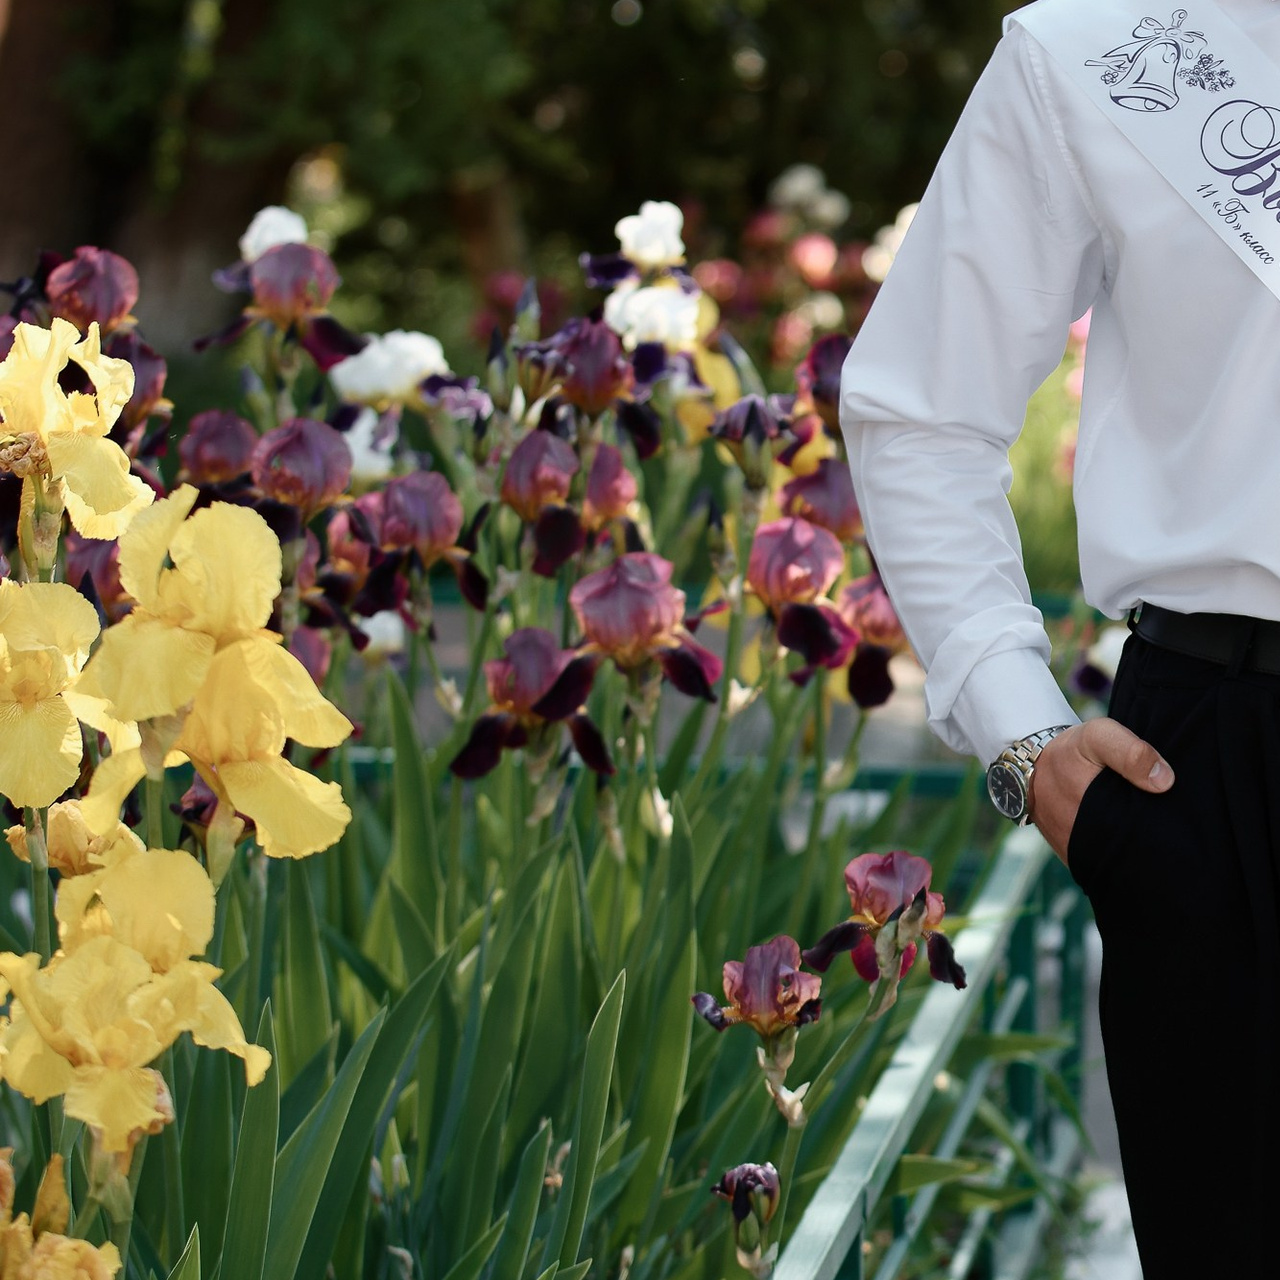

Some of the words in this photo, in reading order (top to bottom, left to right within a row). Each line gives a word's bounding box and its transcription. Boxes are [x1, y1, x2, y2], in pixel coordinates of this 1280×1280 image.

[1196, 183, 1219, 199] 11
[1212, 198, 1250, 230] «Б»
[1239, 231, 1275, 265] класс
